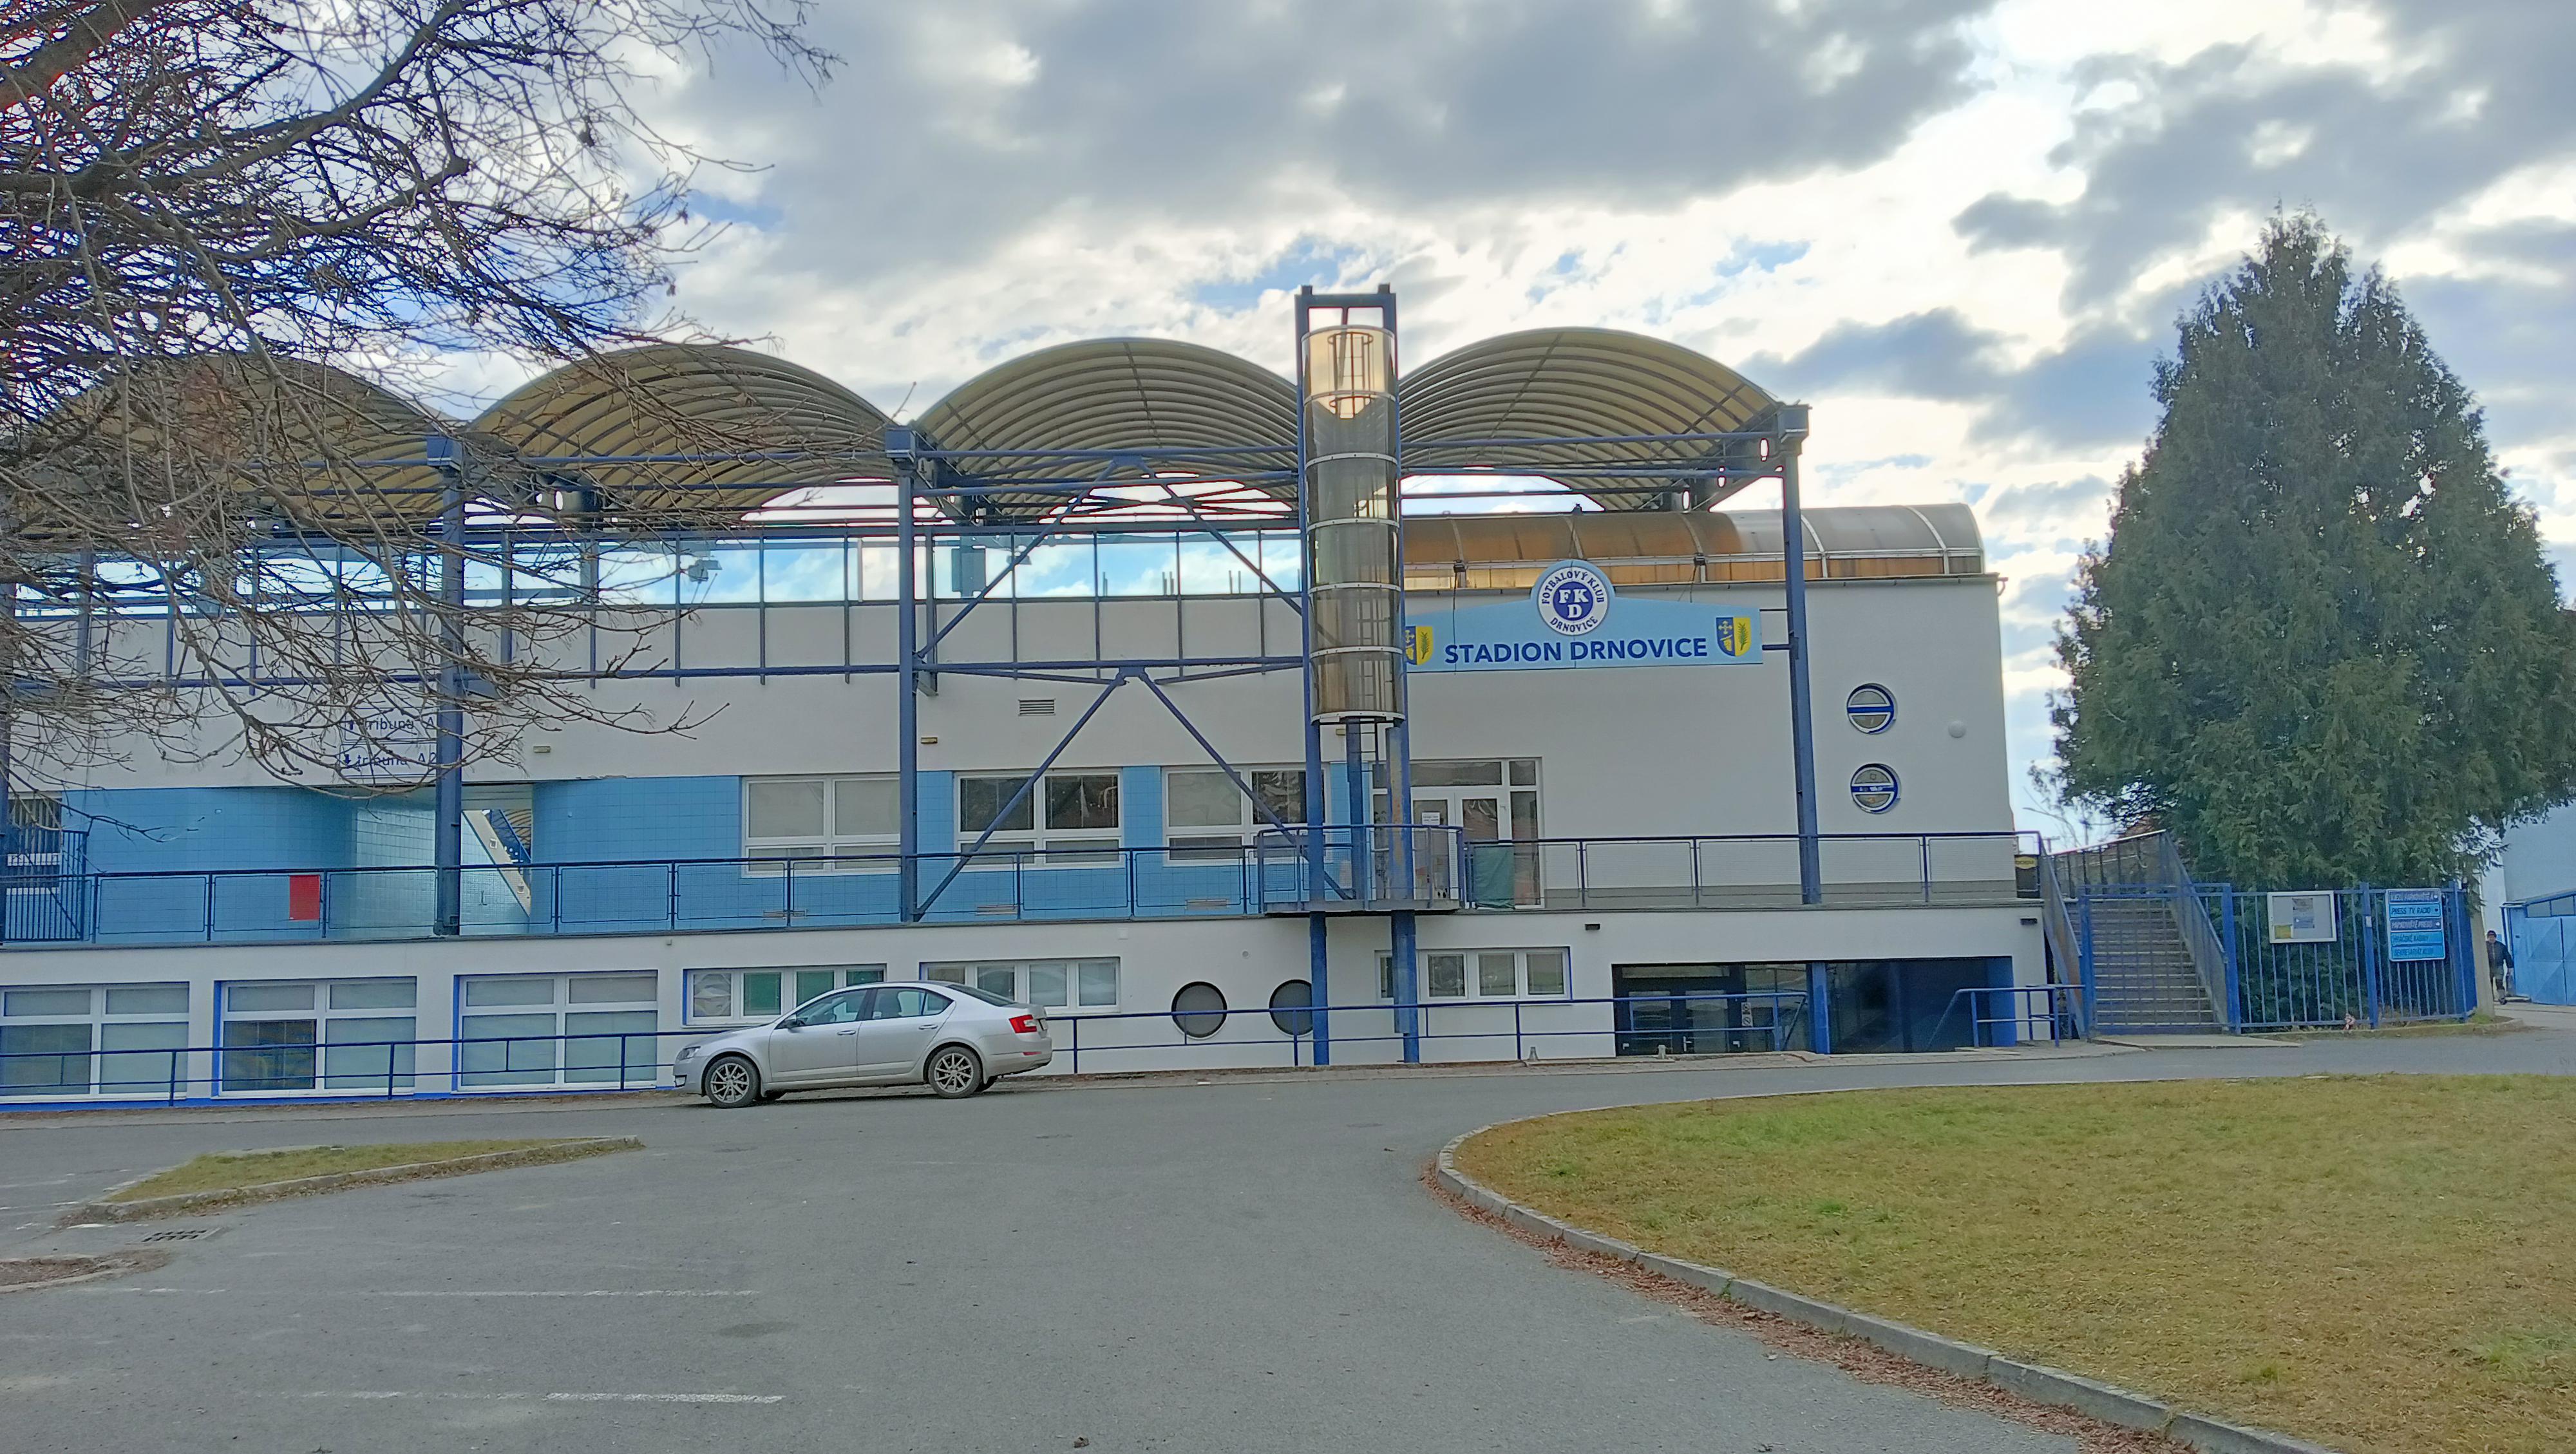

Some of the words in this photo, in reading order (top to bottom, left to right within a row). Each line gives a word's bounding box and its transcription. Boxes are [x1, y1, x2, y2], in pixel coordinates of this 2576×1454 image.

[1542, 571, 1588, 604] FOTBALOVÝ
[1587, 578, 1605, 603] KLUB
[1550, 616, 1598, 632] DRNOVICE
[1444, 642, 1562, 664] STADION
[1570, 637, 1708, 661] DRNOVICE
